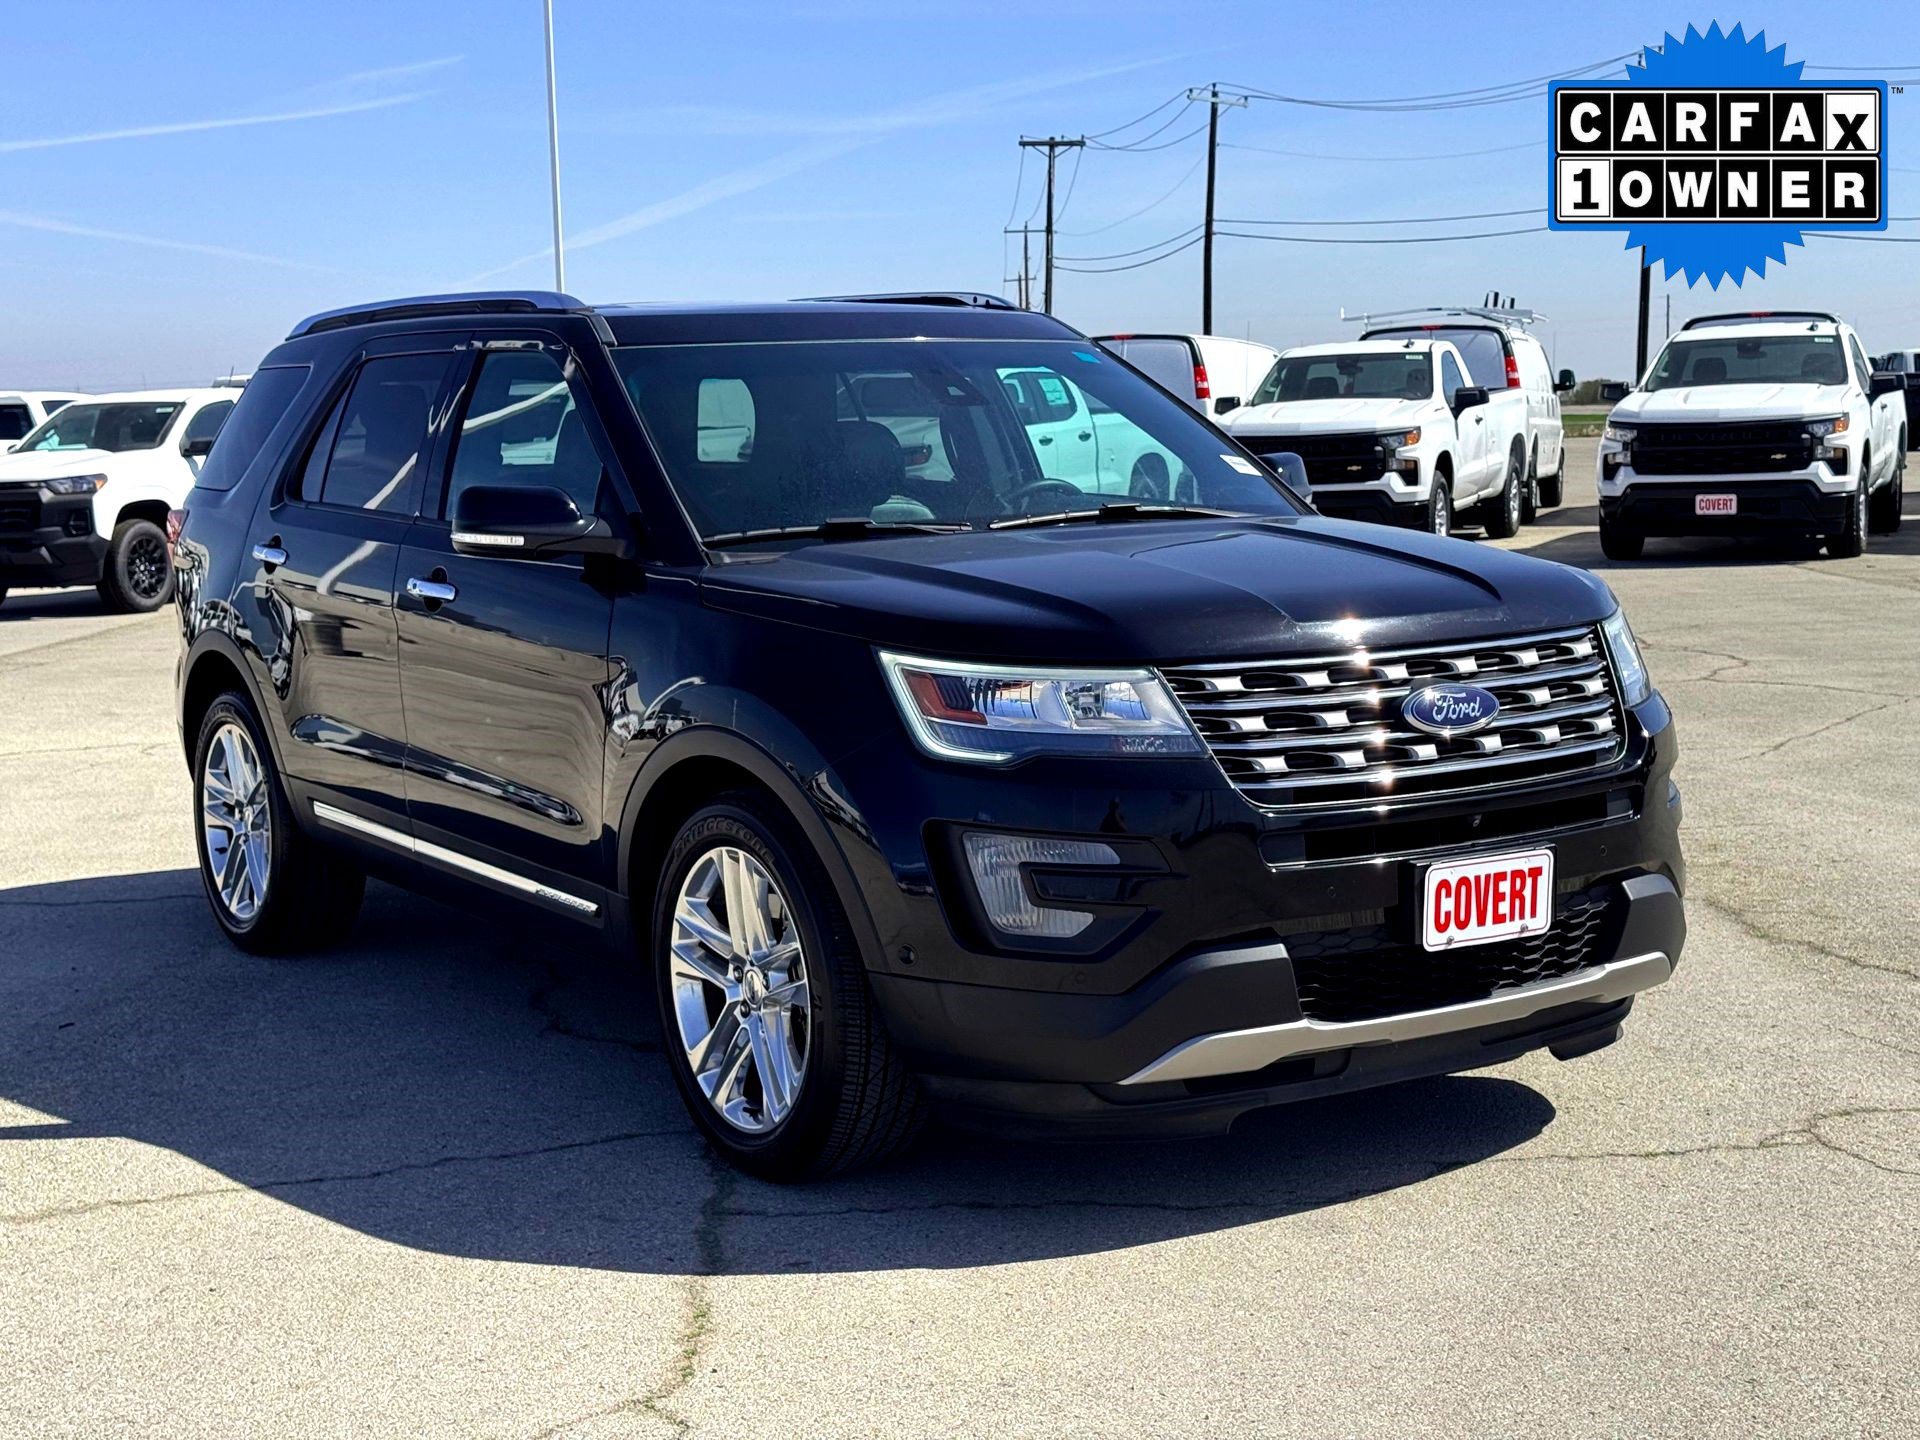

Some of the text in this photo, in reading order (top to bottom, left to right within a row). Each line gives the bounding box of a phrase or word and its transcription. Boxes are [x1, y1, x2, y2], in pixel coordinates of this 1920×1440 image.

[1698, 497, 1733, 511] COVERT
[1432, 691, 1482, 722] Ford
[1434, 866, 1543, 933] COVERT
